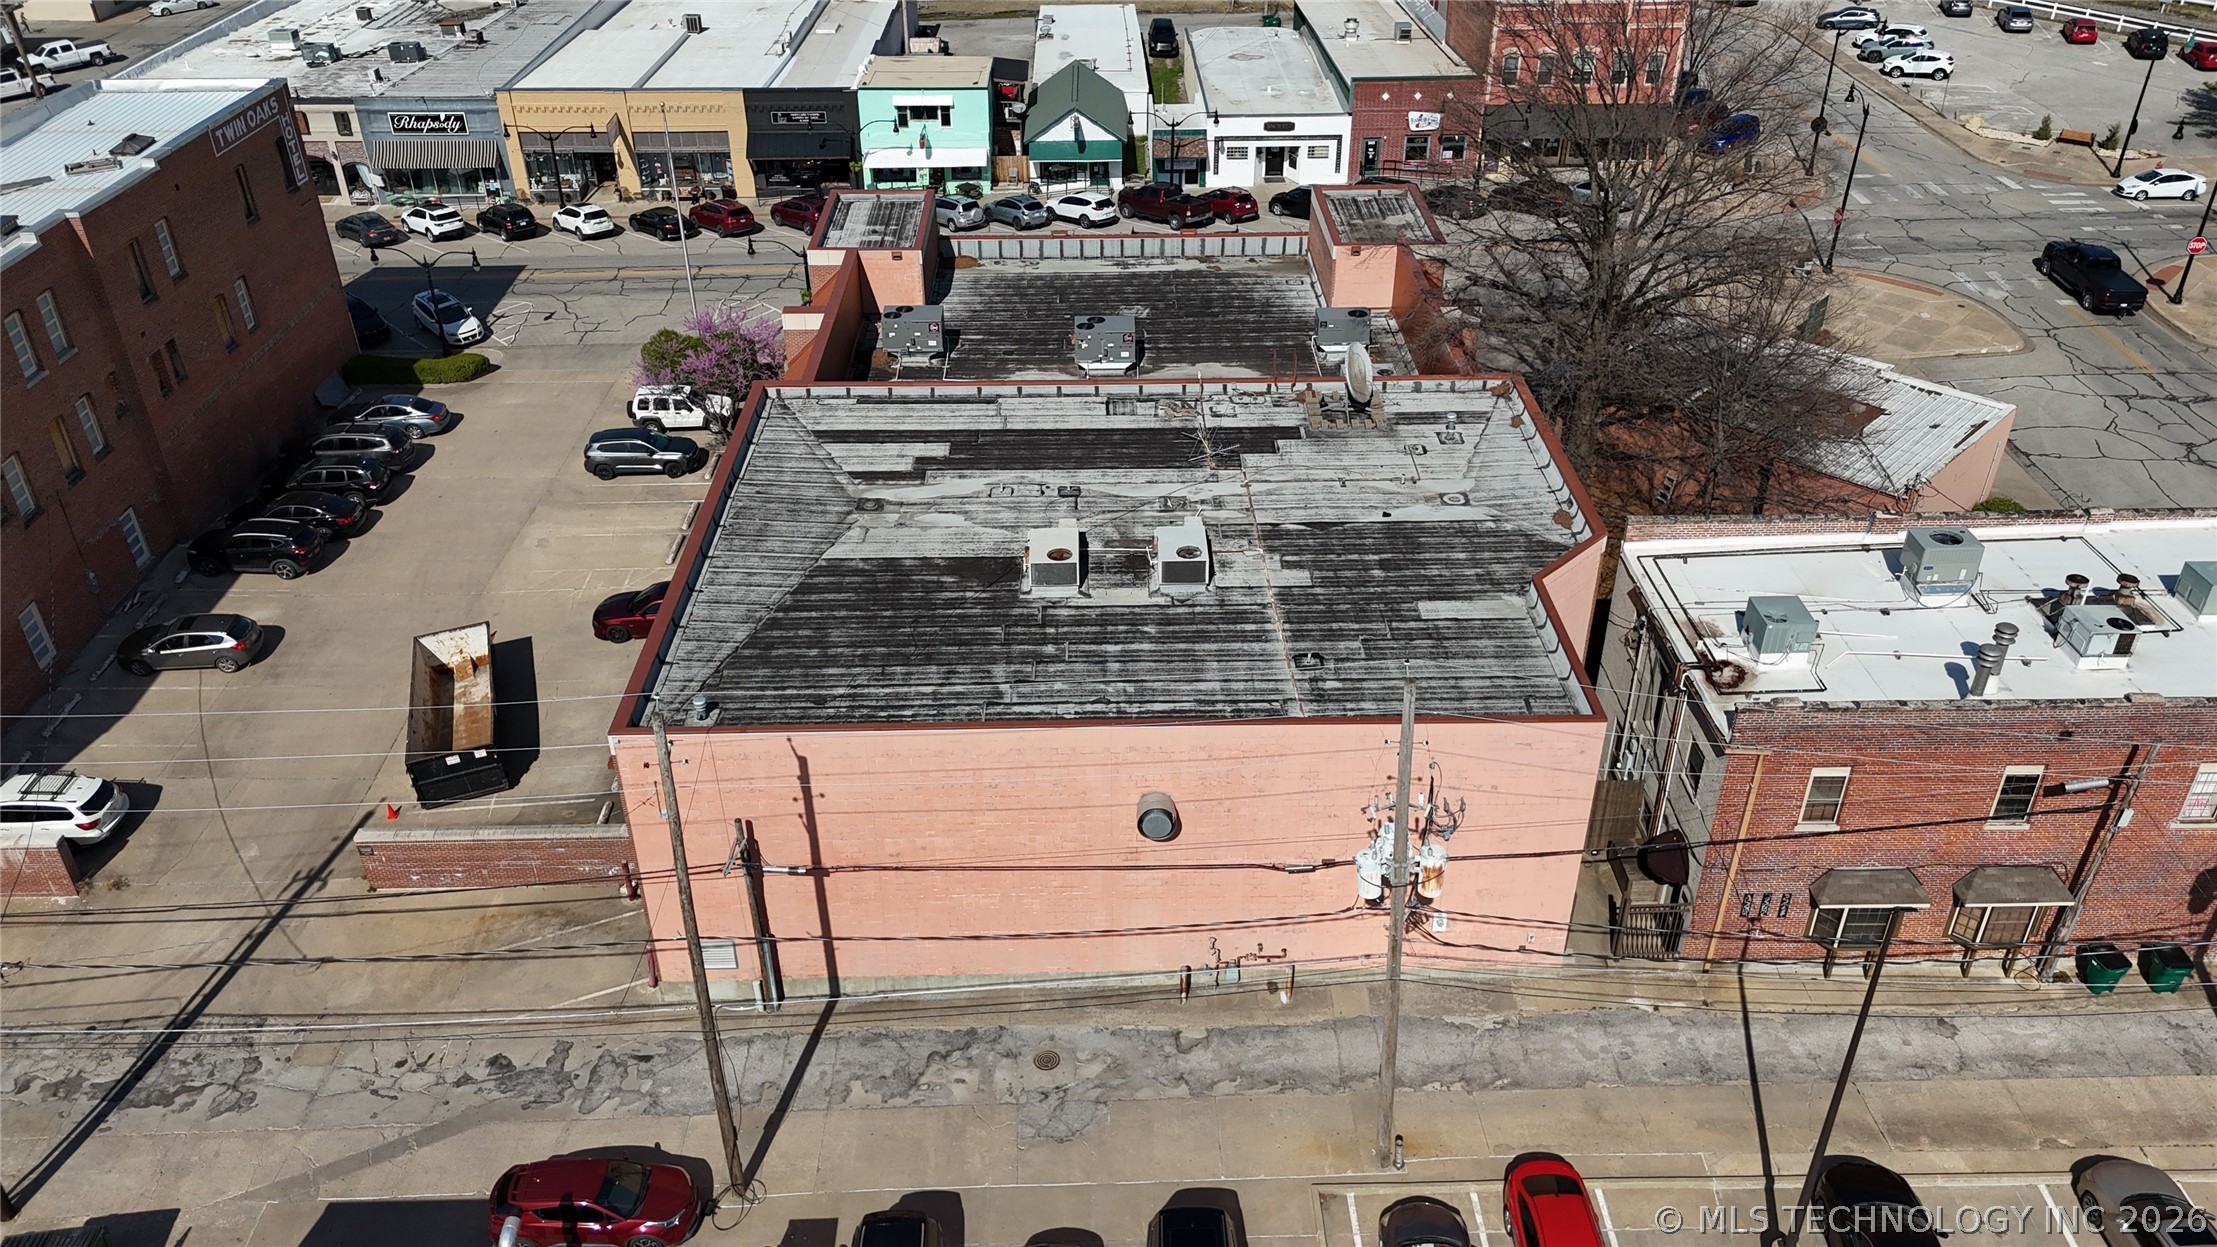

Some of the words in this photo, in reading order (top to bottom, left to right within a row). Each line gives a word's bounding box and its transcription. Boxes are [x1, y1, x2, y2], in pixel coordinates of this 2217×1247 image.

[215, 115, 247, 147] TWIN
[246, 96, 279, 128] OAKS
[394, 115, 463, 134] Rhapsody
[281, 112, 305, 180] HOTEL
[2190, 241, 2206, 249] STOP
